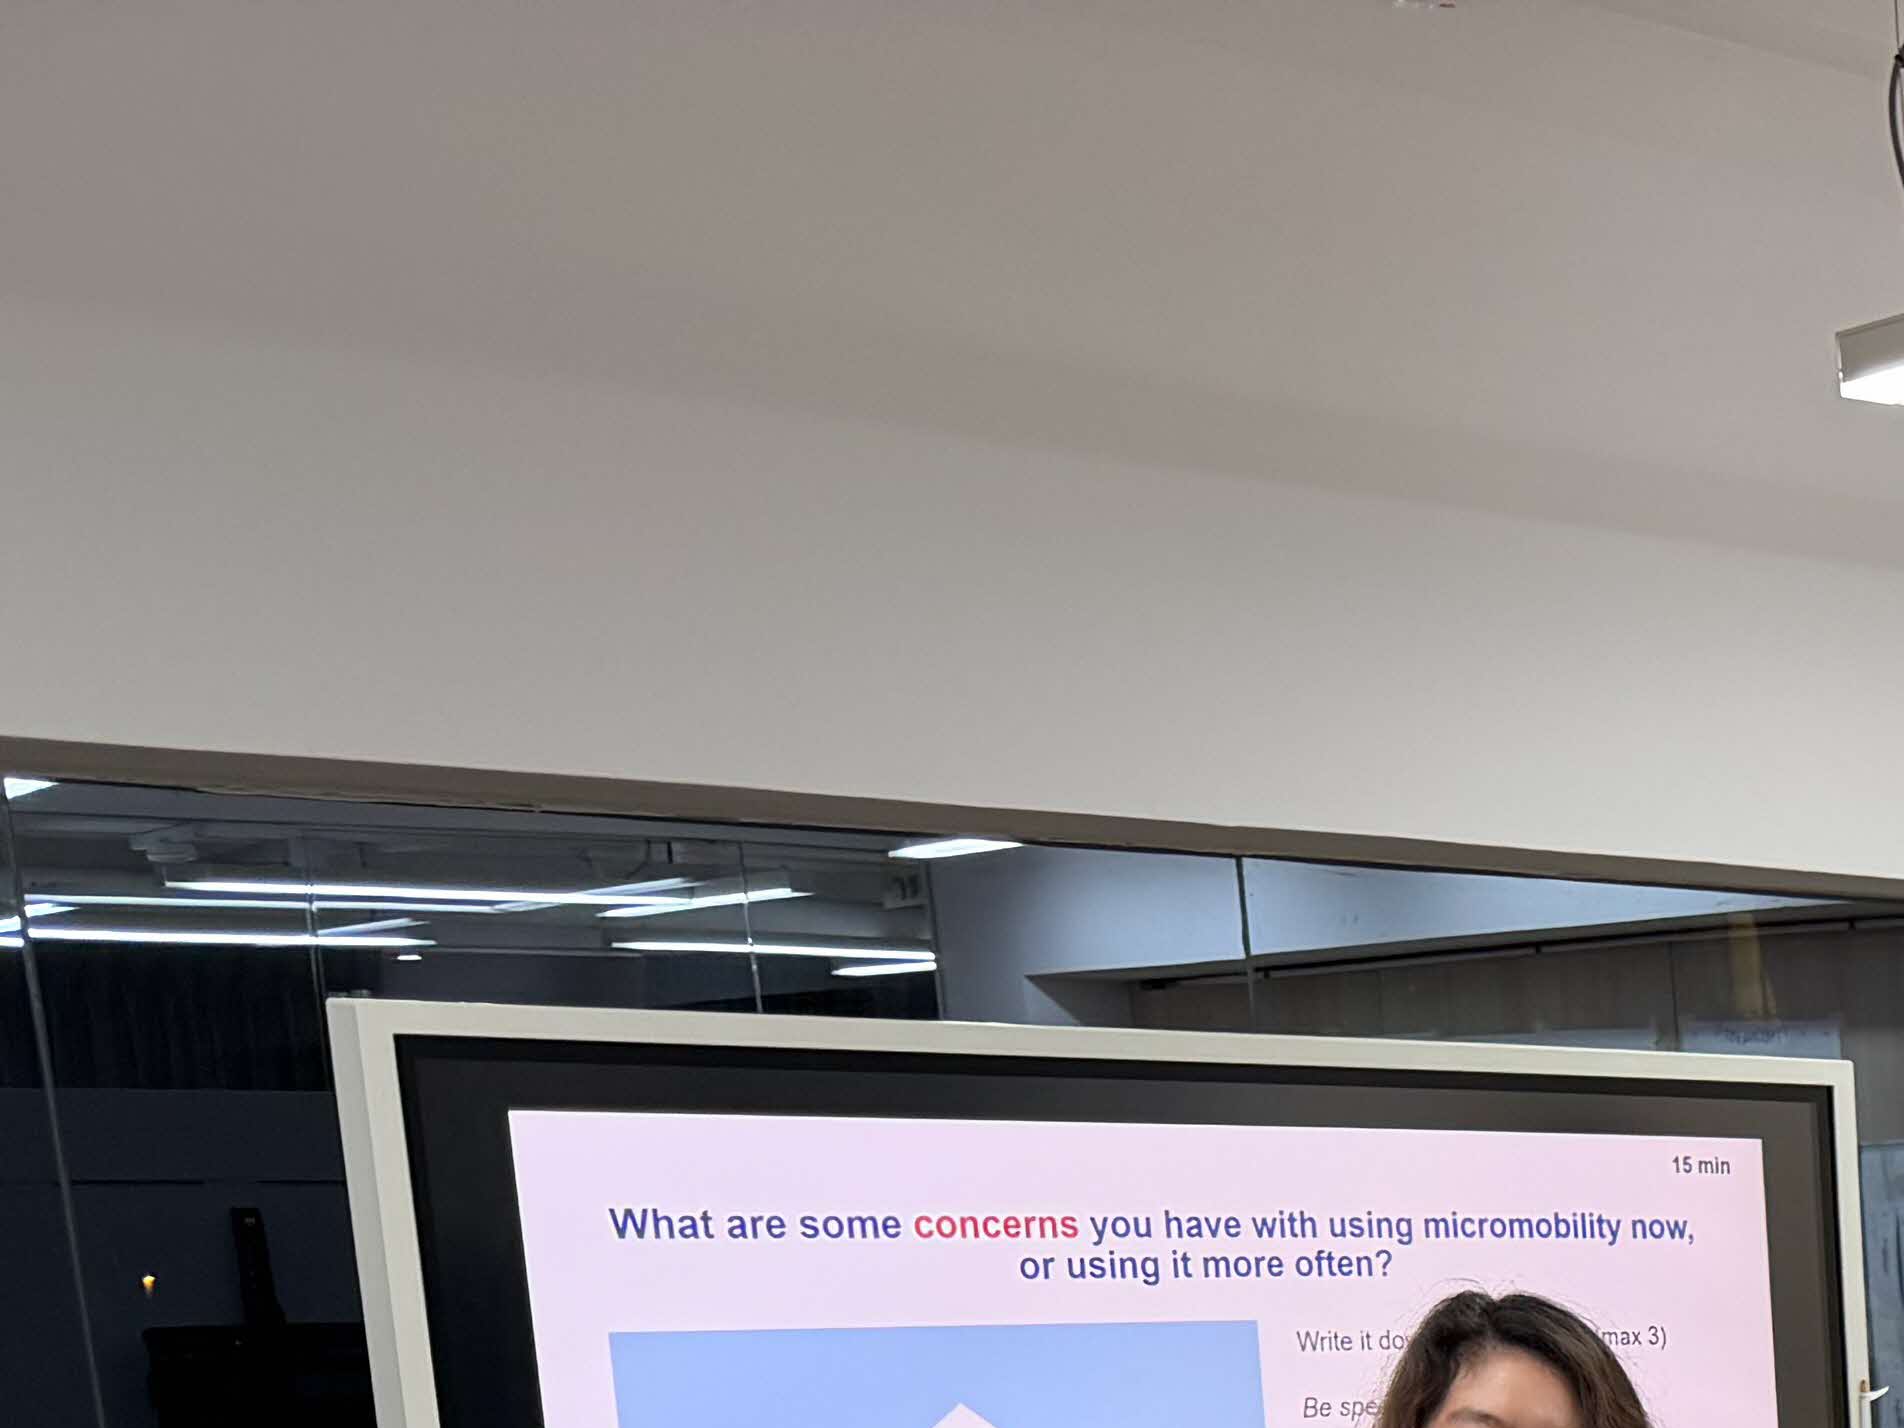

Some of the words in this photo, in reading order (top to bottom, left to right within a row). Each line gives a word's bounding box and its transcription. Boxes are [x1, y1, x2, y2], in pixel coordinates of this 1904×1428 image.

[1672, 1156, 1691, 1174] 15
[1698, 1156, 1730, 1175] min
[609, 1208, 714, 1240] What
[727, 1214, 786, 1240] are
[800, 1214, 900, 1240] some
[914, 1211, 1079, 1240] concerns
[1090, 1214, 1151, 1245] you
[1164, 1210, 1241, 1239] have
[1251, 1209, 1317, 1239] with
[1329, 1211, 1413, 1245] using
[1424, 1211, 1621, 1246] micromobility
[1630, 1217, 1694, 1245] now,
[1020, 1252, 1054, 1279] or
[1067, 1250, 1160, 1284] using
[1172, 1249, 1192, 1279] it
[1202, 1252, 1283, 1278] more
[1295, 1250, 1392, 1278] often?
[1296, 1330, 1352, 1352] Write
[1361, 1330, 1374, 1351] it
[1379, 1330, 1410, 1351] do
[1598, 1328, 1643, 1347] max
[1648, 1326, 1667, 1351] 3)
[1303, 1397, 1332, 1418] Be
[1340, 1400, 1379, 1425] spe
